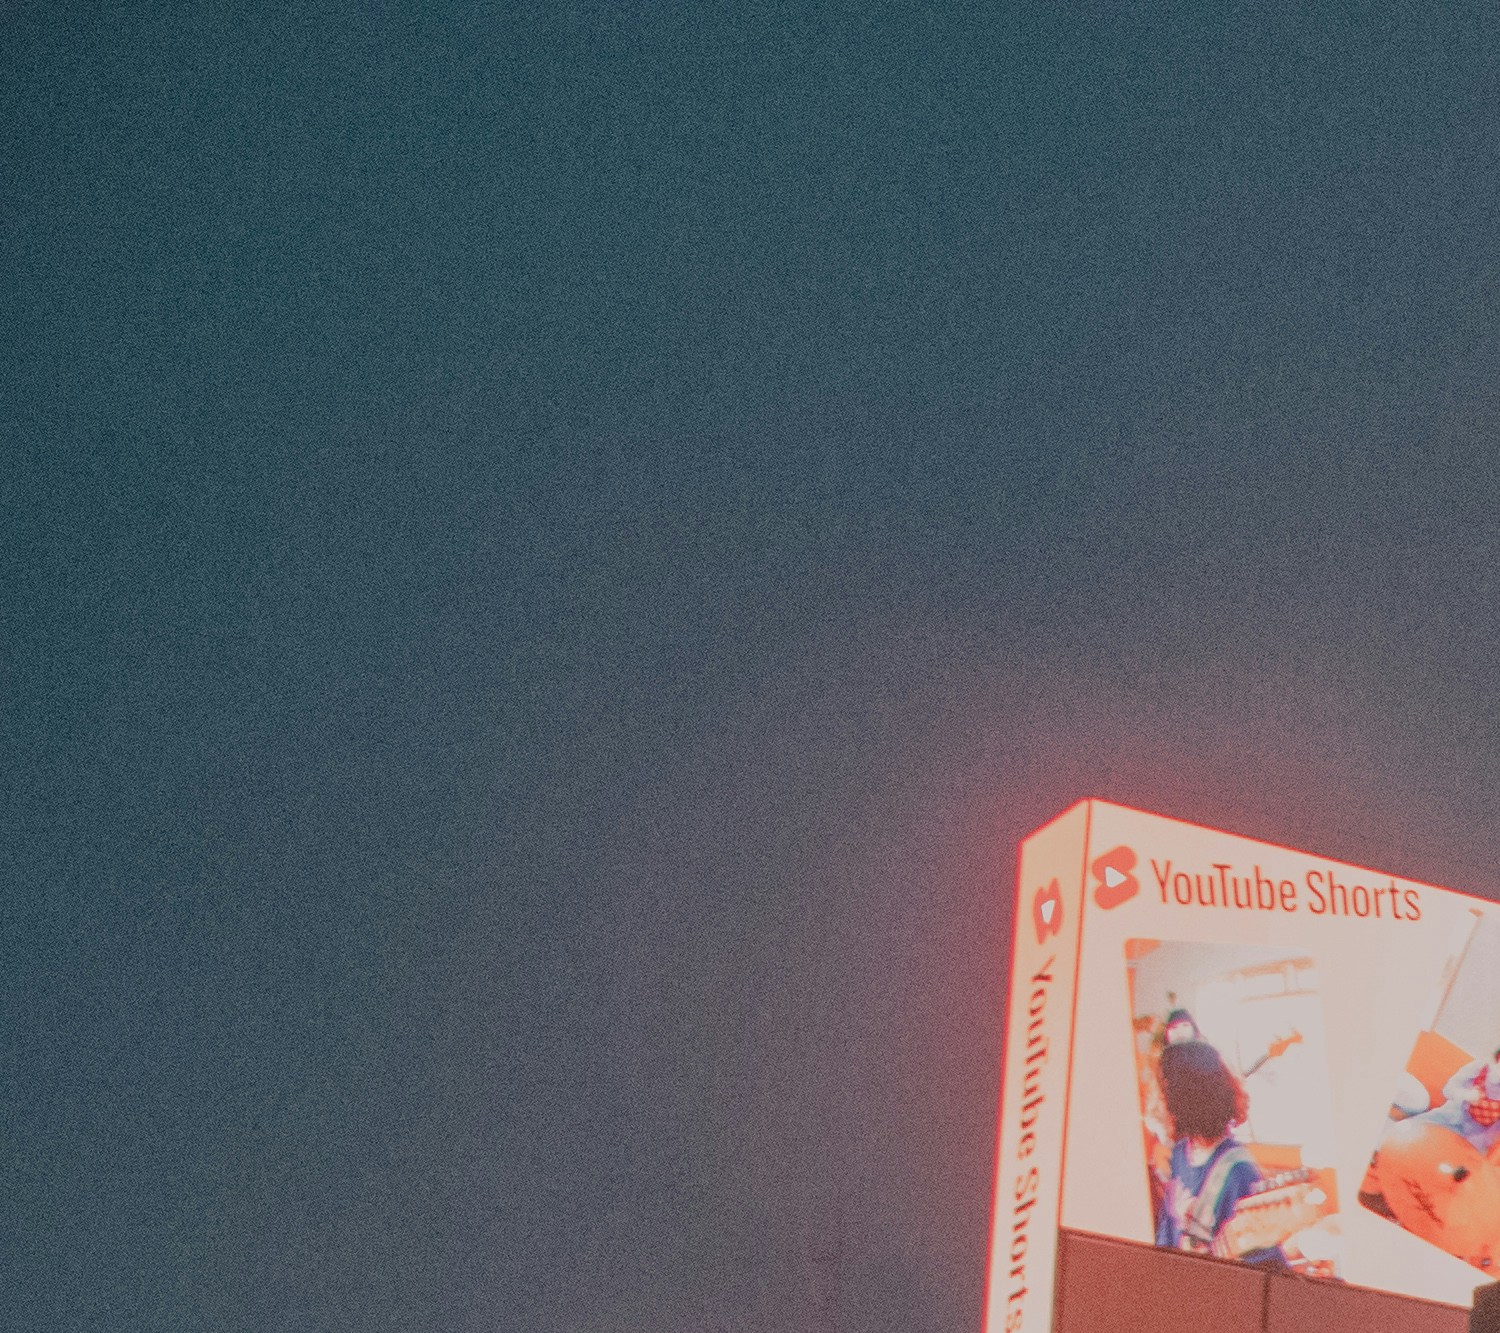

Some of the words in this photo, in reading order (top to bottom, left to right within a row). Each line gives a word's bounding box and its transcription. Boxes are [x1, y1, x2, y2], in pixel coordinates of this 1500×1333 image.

[1149, 856, 1298, 913] YouTube
[1306, 869, 1422, 922] Shorts
[1017, 954, 1055, 1160] YouTube
